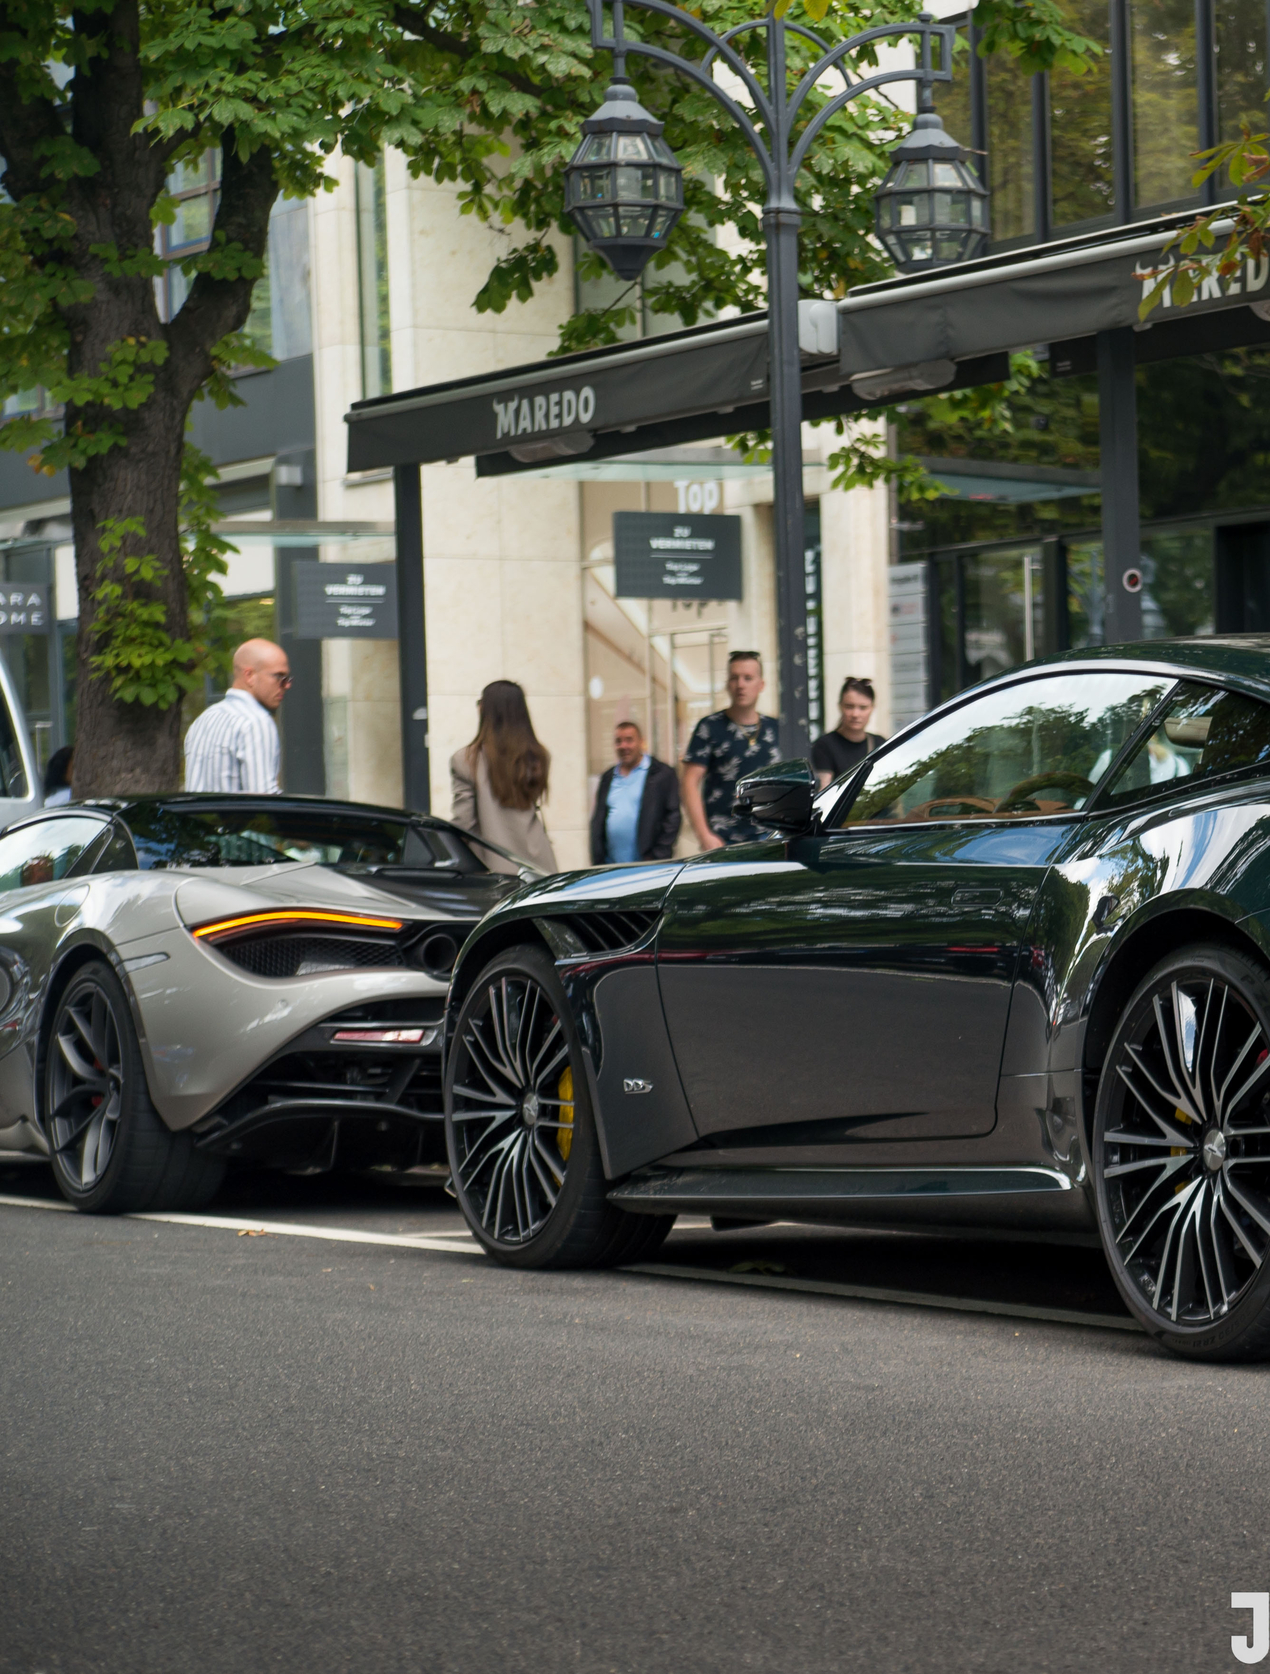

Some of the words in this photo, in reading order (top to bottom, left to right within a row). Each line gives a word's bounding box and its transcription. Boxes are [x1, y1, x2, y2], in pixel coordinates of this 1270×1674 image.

[492, 385, 596, 440] MAREDO
[673, 526, 691, 537] ZU
[649, 537, 715, 550] VERMIETEN
[346, 573, 364, 585] ZU
[324, 584, 386, 595] VERMIETEN
